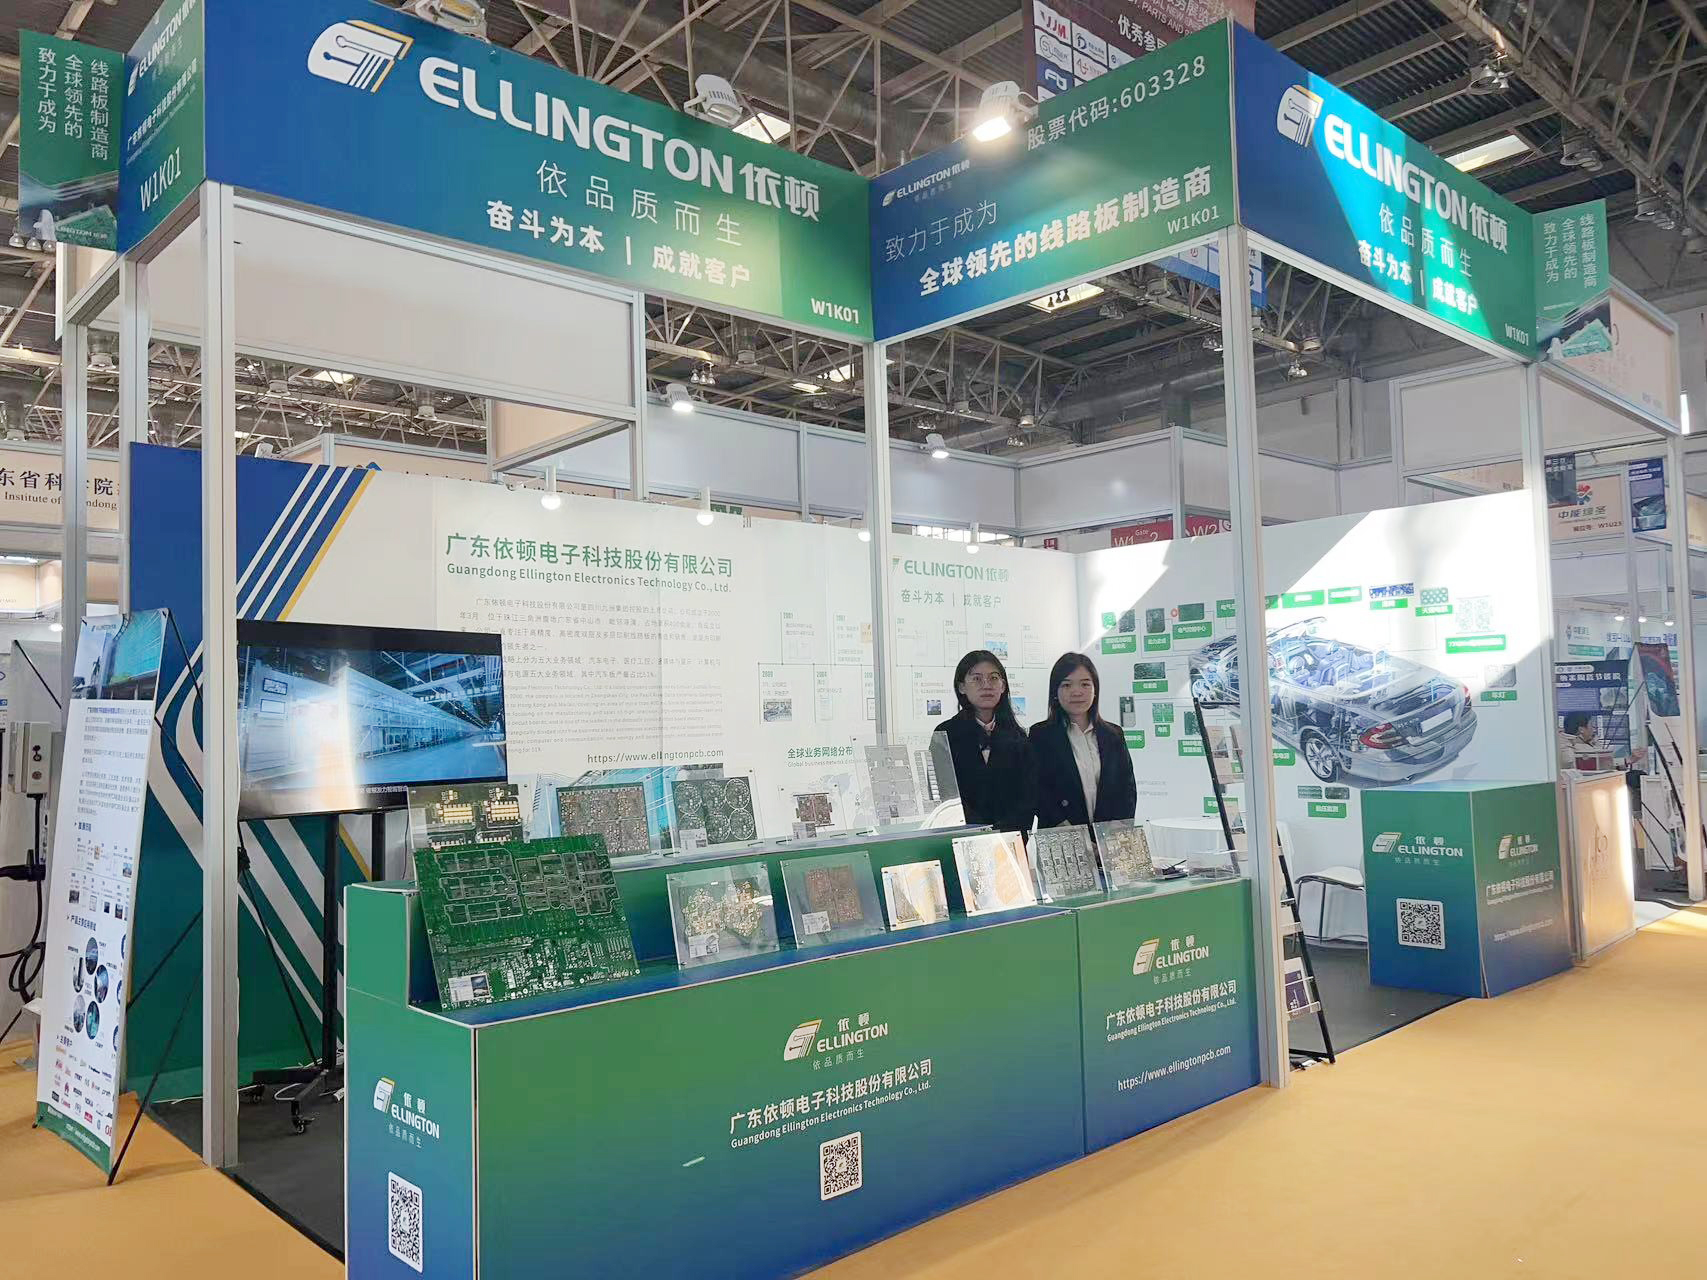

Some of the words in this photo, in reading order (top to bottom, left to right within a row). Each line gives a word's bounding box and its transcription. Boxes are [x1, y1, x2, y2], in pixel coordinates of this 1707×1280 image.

[139, 7, 182, 78] ELLINGTON
[38, 47, 57, 133] 致力于成为
[64, 54, 84, 138] 全球领先的
[90, 59, 109, 161] 线路板制造商
[419, 56, 734, 195] ELLINGTON
[738, 162, 821, 223] 依顿
[140, 146, 182, 212] W1K01
[896, 168, 951, 199] ELLINGTON
[1324, 113, 1469, 230] ELLINGTON
[1468, 201, 1508, 255] 依顿
[536, 159, 745, 247] 依品质而生
[1167, 205, 1220, 235] W1K01
[486, 200, 606, 255] 奋斗为本
[652, 245, 751, 289] 成就客户
[885, 200, 998, 263] 致力于成为
[919, 165, 1212, 297] 全球领先的线路板制造商
[1378, 202, 1473, 279] 依品质而生
[1561, 217, 1578, 280] 全球领先的
[1357, 239, 1413, 287] 奋斗为本
[1543, 222, 1560, 284] 致力于成为
[811, 297, 860, 325] W1K01
[1504, 322, 1530, 347] W1K01
[5, 491, 48, 504] Institute
[51, 495, 62, 505] of
[86, 499, 118, 511] ndong
[1114, 535, 1135, 547] W1
[1135, 528, 1149, 536] Gate
[446, 532, 733, 578] 广东依顿电子科技股份有限公司
[903, 559, 984, 581] ELLINGTON
[447, 562, 516, 581] Guangdong
[519, 568, 572, 584] Ellington
[574, 571, 636, 587] Electronics
[637, 575, 693, 591] Technology
[714, 582, 732, 593] Ltd.
[900, 588, 945, 605] 奋斗为本
[787, 746, 853, 759] 全球业务网络分布
[1397, 845, 1464, 858] ELLINGTON
[1155, 946, 1210, 969] ELLINGTON
[1170, 934, 1195, 952] 依顿
[837, 1012, 870, 1033] 依顿
[1106, 979, 1237, 1031] 广东依顿电子科技股份有限公司
[1107, 1025, 1138, 1043] Guangdong
[1138, 1017, 1162, 1034] Ellington
[1161, 1011, 1190, 1027] Electronics
[1189, 1004, 1217, 1021] Technology
[816, 1022, 889, 1053] ELLINGTON
[812, 1048, 866, 1071] 依品质而生
[1117, 1044, 1232, 1092] https://www.ellingtonpcb.com
[403, 1091, 427, 1115] 依顿
[729, 1058, 933, 1135] 广东依顿电子科技股份有限公司
[731, 1126, 781, 1149] Guangdong
[782, 1116, 820, 1135] Ellington
[820, 1102, 863, 1123] Electronics
[863, 1089, 904, 1109] Technology
[904, 1086, 918, 1096] Co.,
[918, 1080, 931, 1092] Ltd.
[391, 1103, 440, 1139] ELLINGTON
